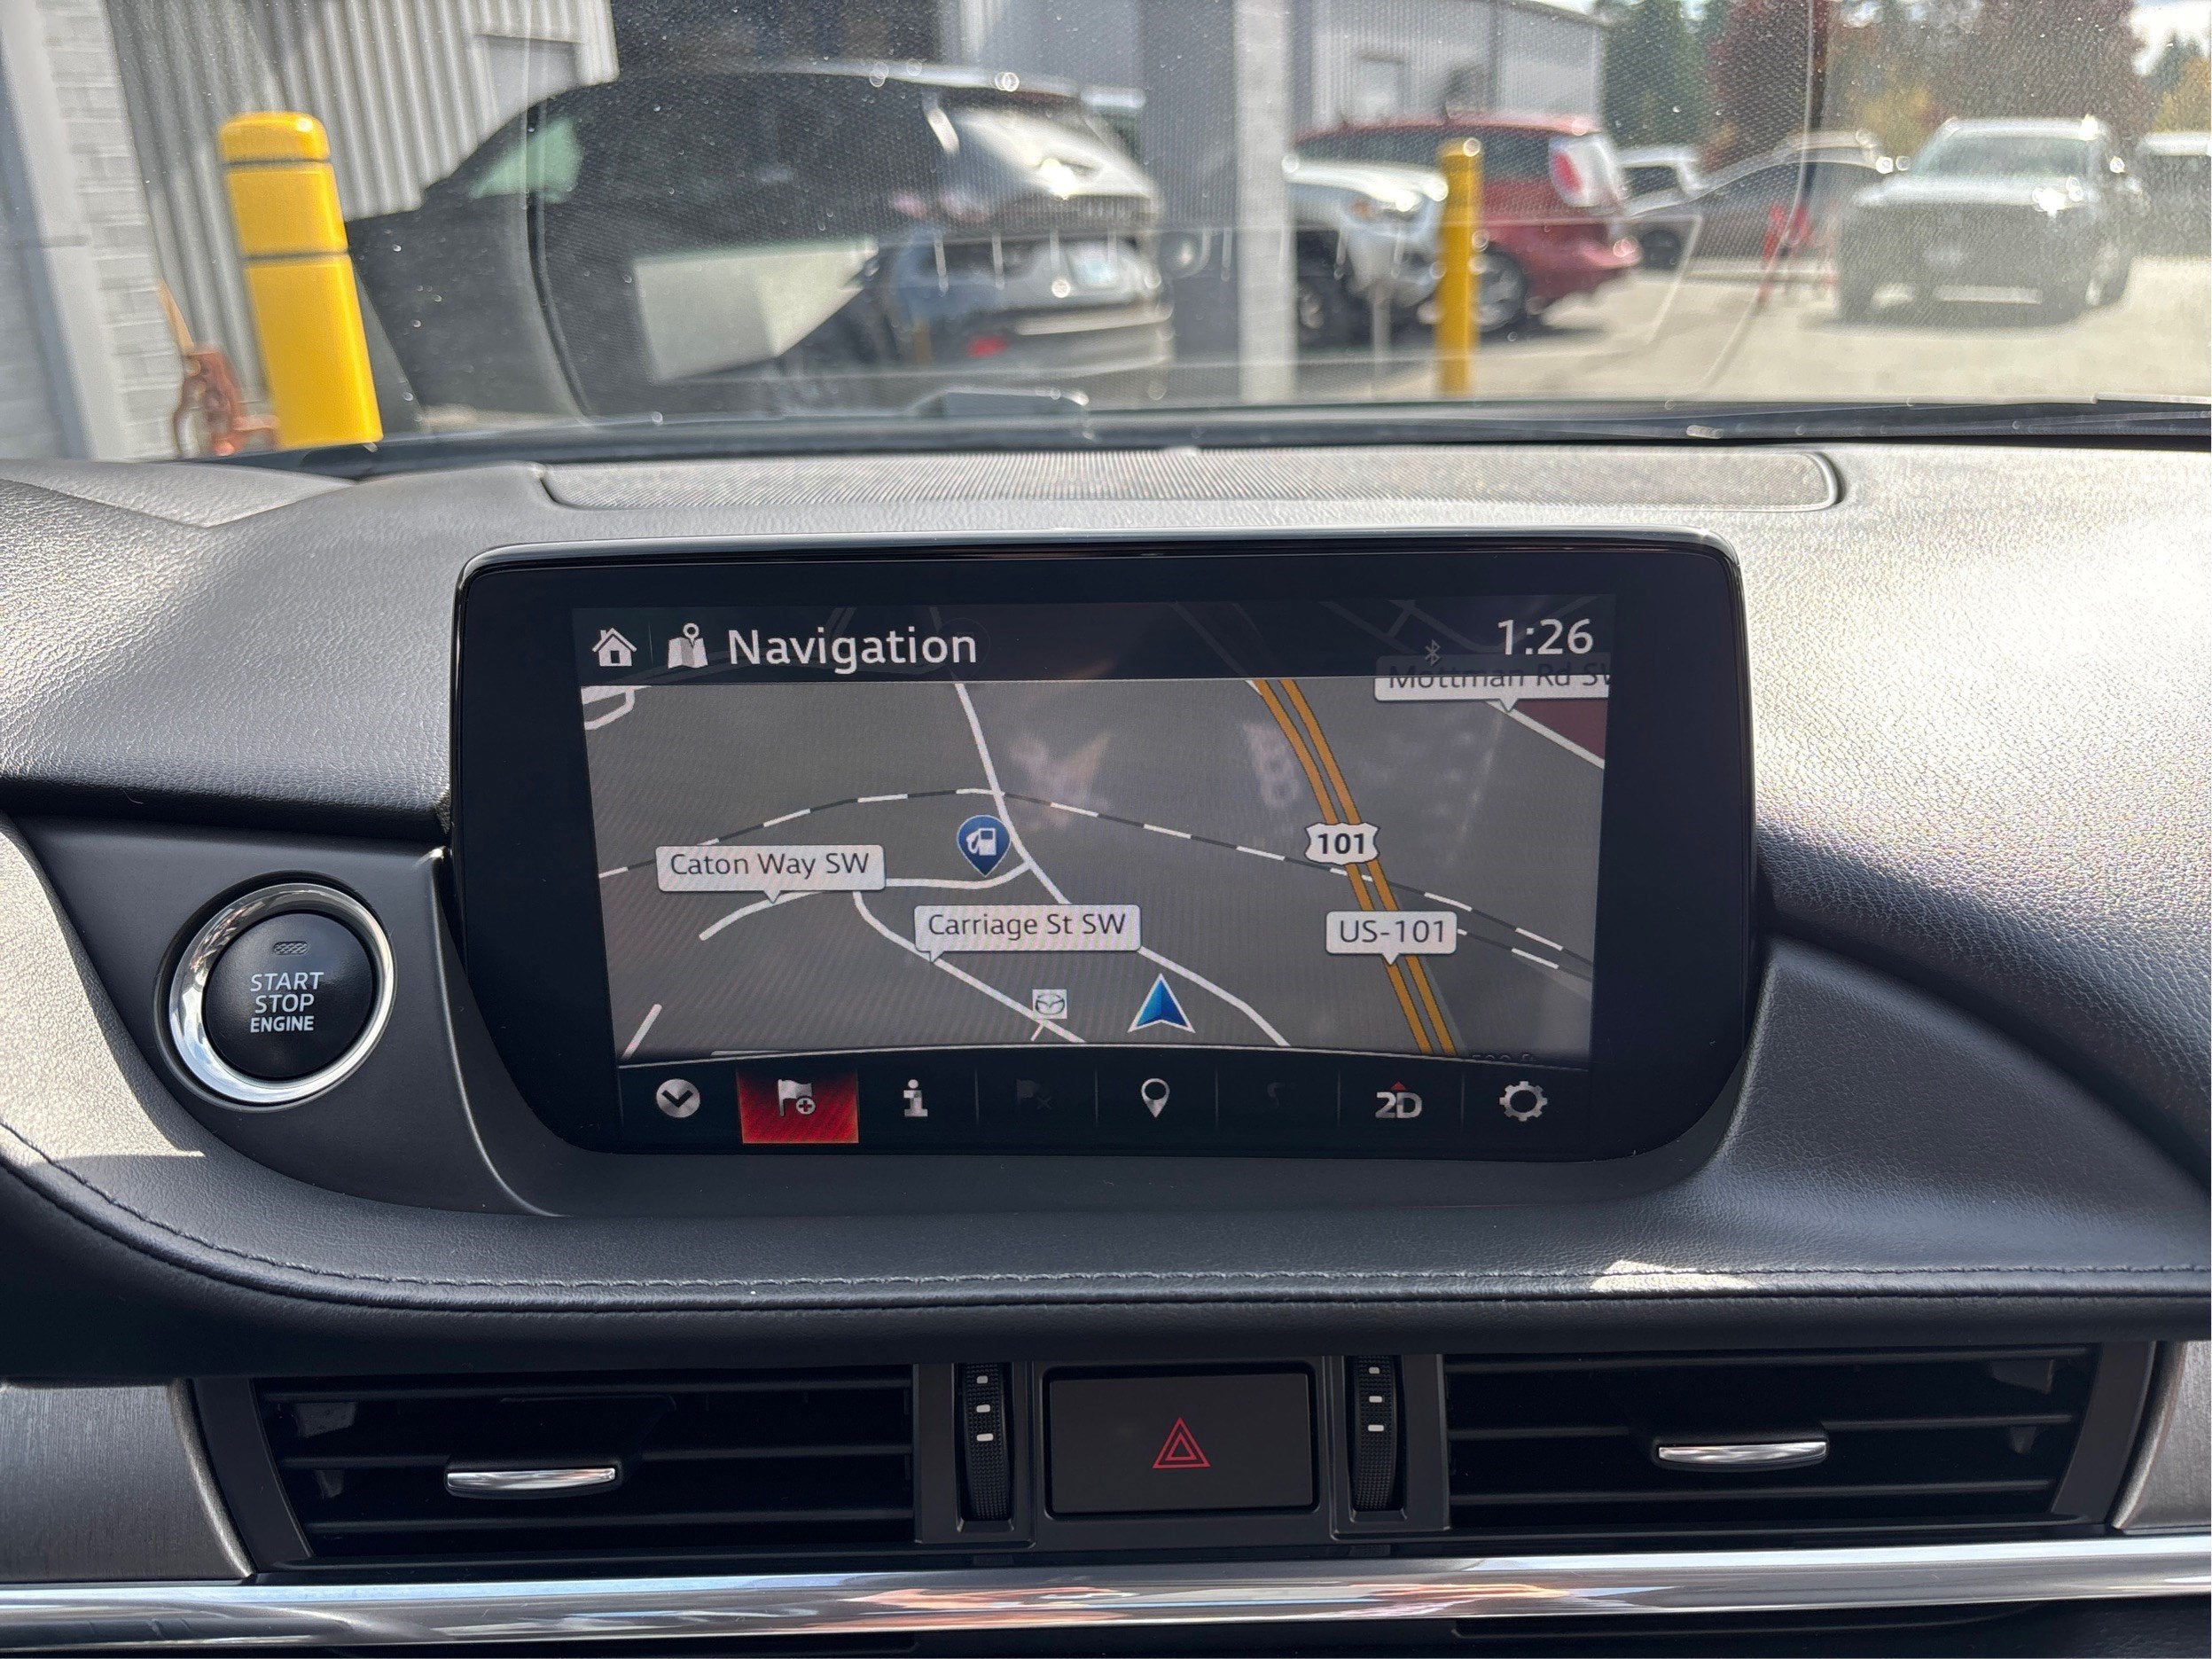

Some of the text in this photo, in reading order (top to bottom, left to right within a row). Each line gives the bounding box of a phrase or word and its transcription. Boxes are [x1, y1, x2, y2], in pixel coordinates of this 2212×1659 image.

[727, 625, 978, 675] Navigation
[1497, 618, 1595, 656] 1:26
[1388, 665, 1525, 689] Mottman
[1536, 661, 1572, 687] Rd
[1316, 832, 1366, 856] 101
[670, 852, 870, 880] Caton Way SW
[928, 912, 1127, 941] Carriage St SW
[1339, 919, 1446, 943] US-101
[249, 971, 324, 992] START
[254, 993, 316, 1014] STOP
[249, 1015, 315, 1033] ENGINE
[1374, 1091, 1424, 1120] 2D
